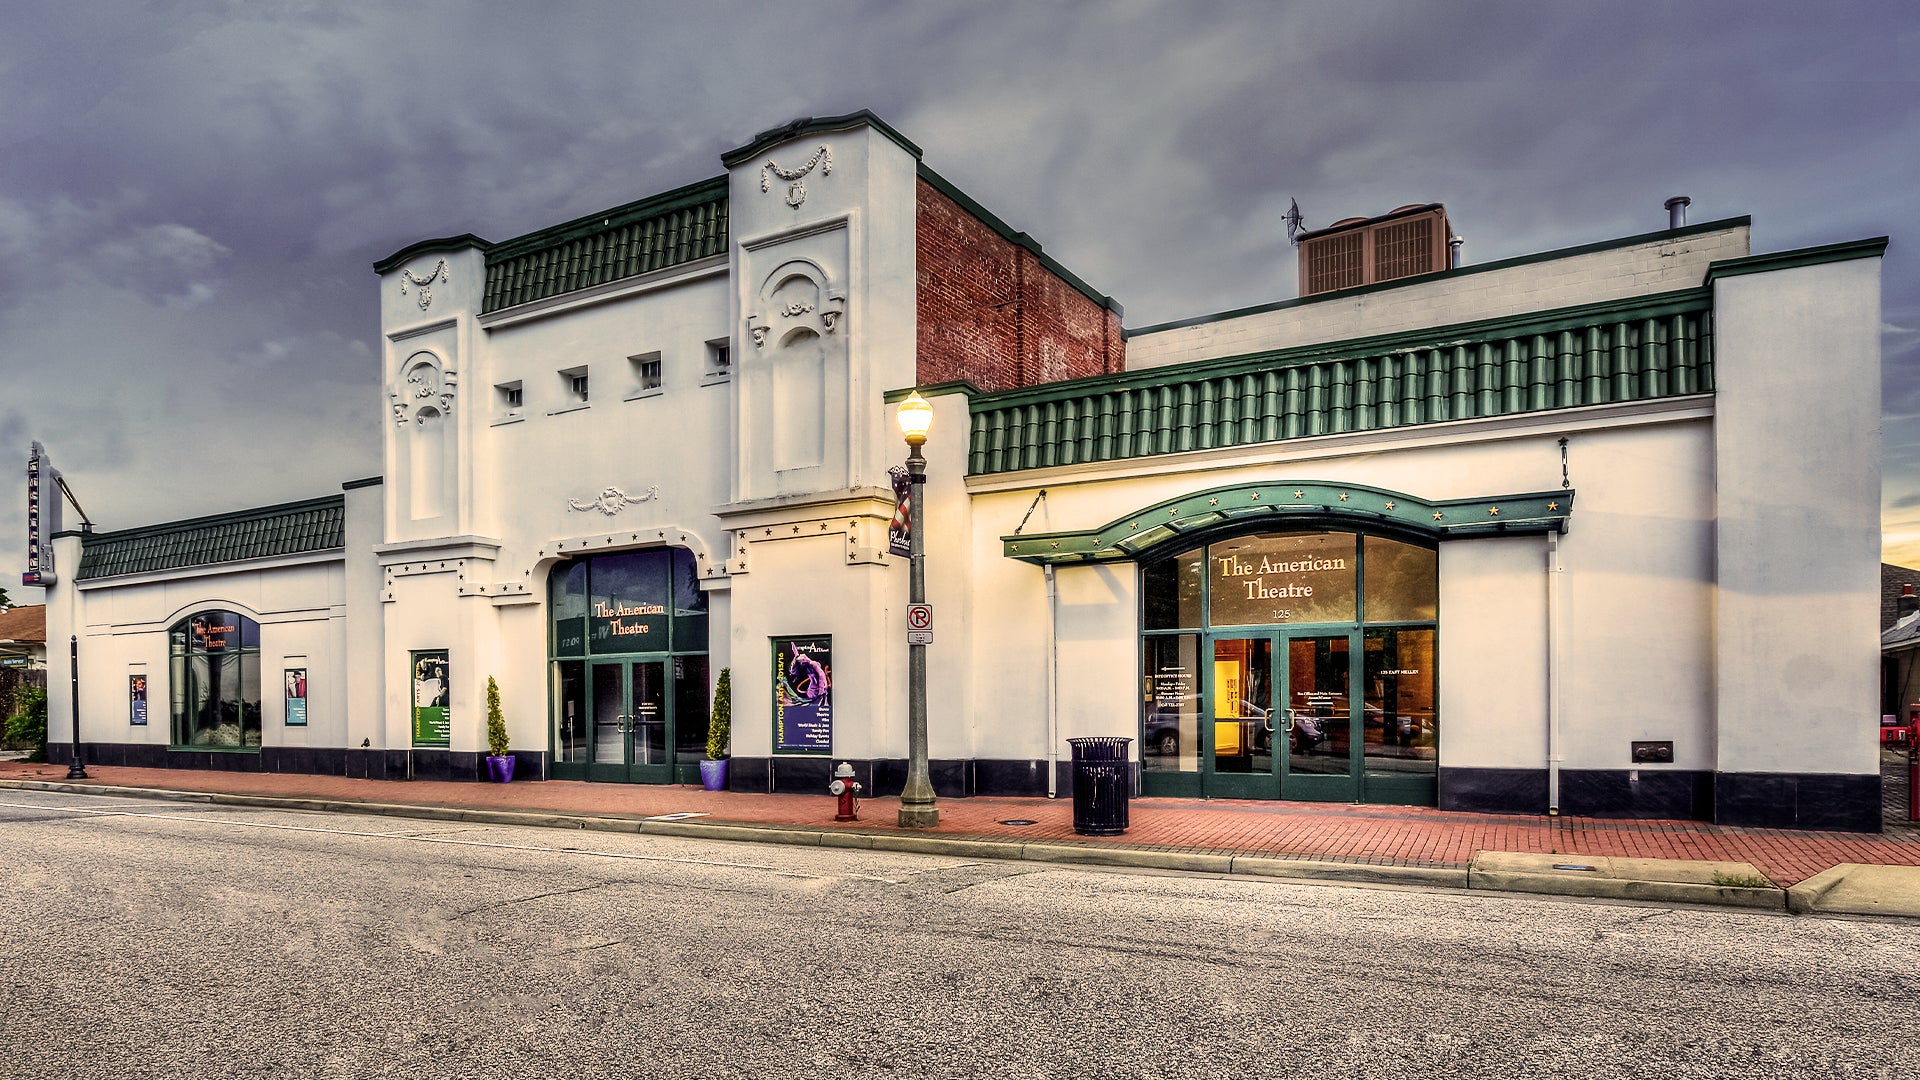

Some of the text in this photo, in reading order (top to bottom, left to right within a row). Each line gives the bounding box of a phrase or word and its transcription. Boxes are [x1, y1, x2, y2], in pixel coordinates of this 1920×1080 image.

[1218, 555, 1346, 577] The American
[1243, 577, 1313, 600] Theatre
[595, 601, 665, 618] The American
[1273, 610, 1291, 619] 125
[207, 624, 236, 633] American
[610, 618, 649, 635] Theatre
[204, 635, 227, 647] Theatre
